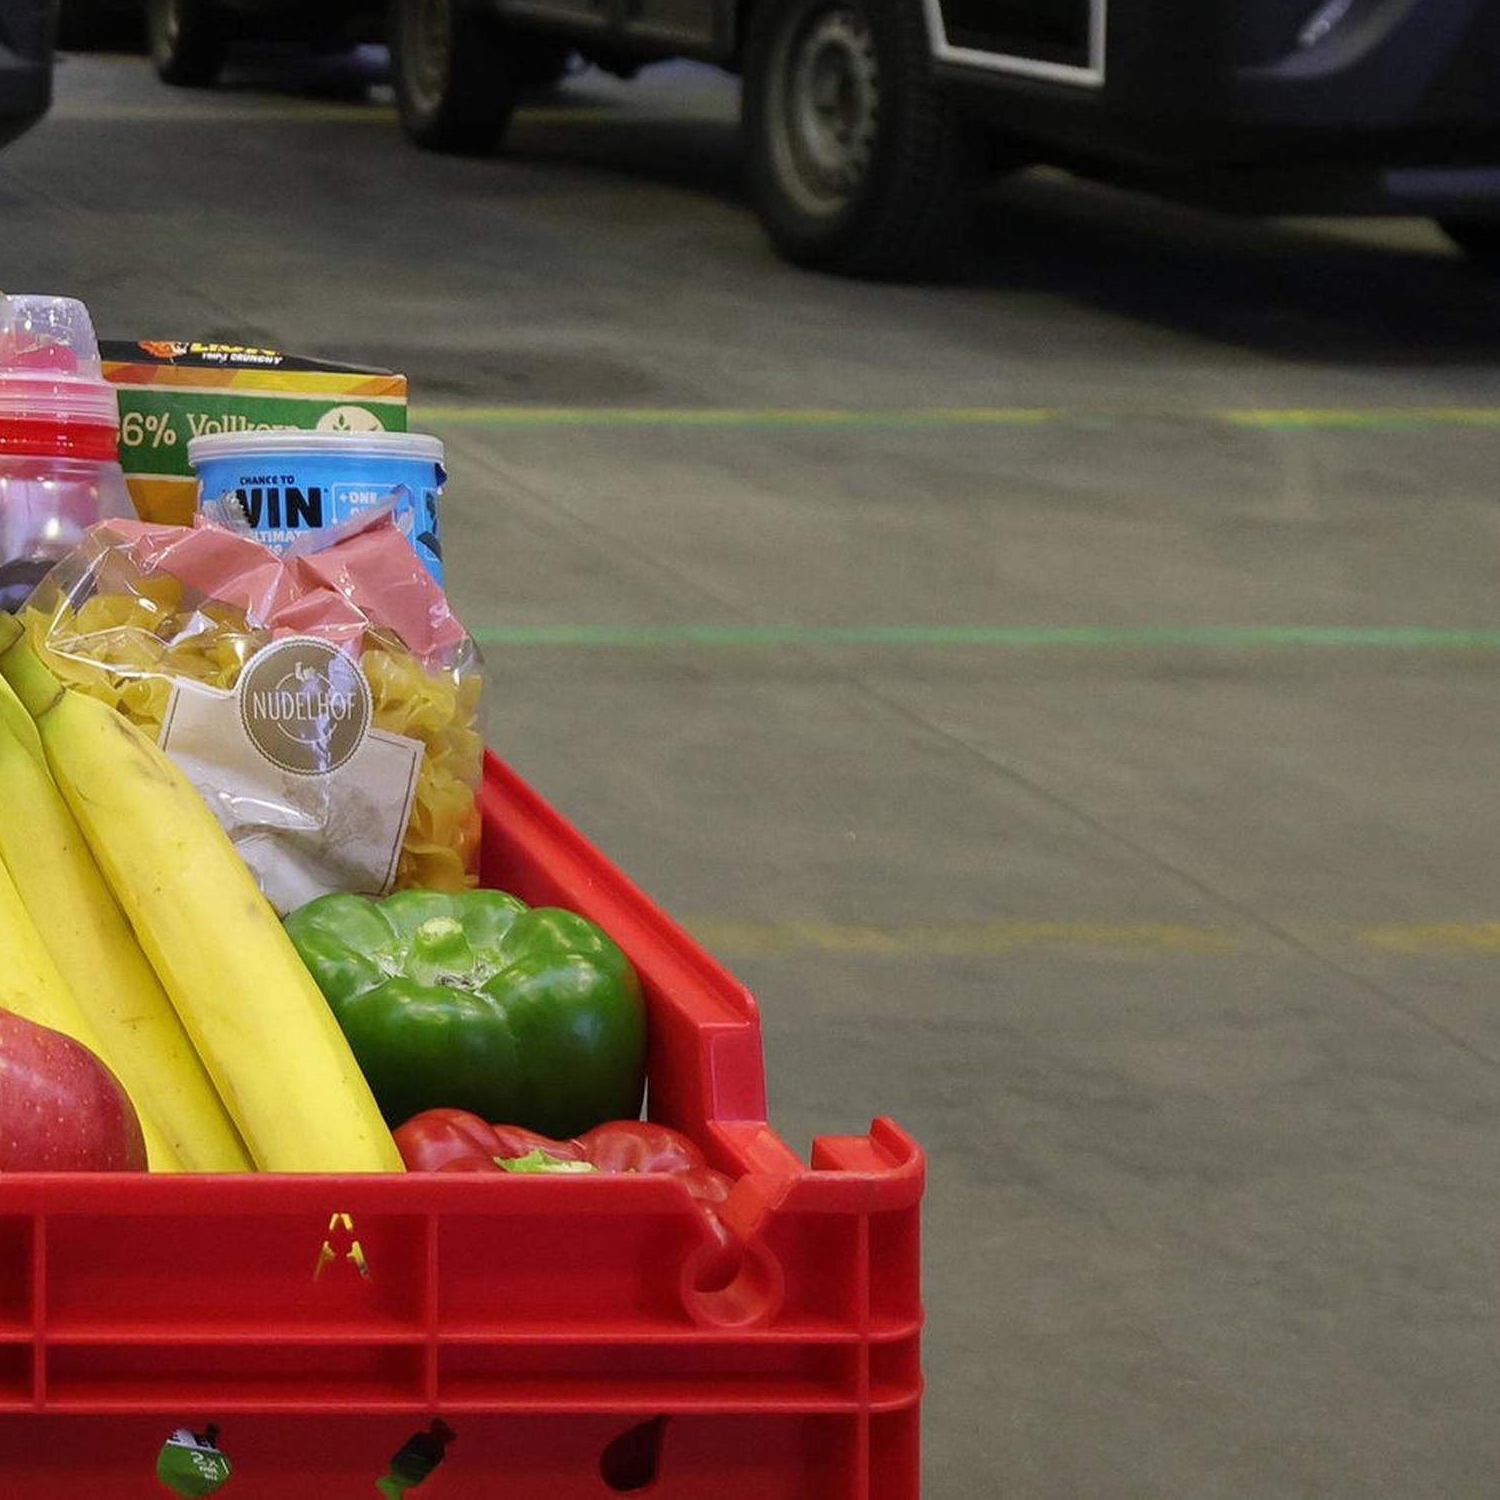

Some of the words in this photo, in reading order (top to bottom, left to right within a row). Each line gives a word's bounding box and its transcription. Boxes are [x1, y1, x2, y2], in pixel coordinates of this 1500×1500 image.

[116, 412, 177, 447] 6%
[239, 476, 278, 486] CHANCE
[280, 475, 296, 484] TO
[253, 691, 357, 721] NUDELHOF
